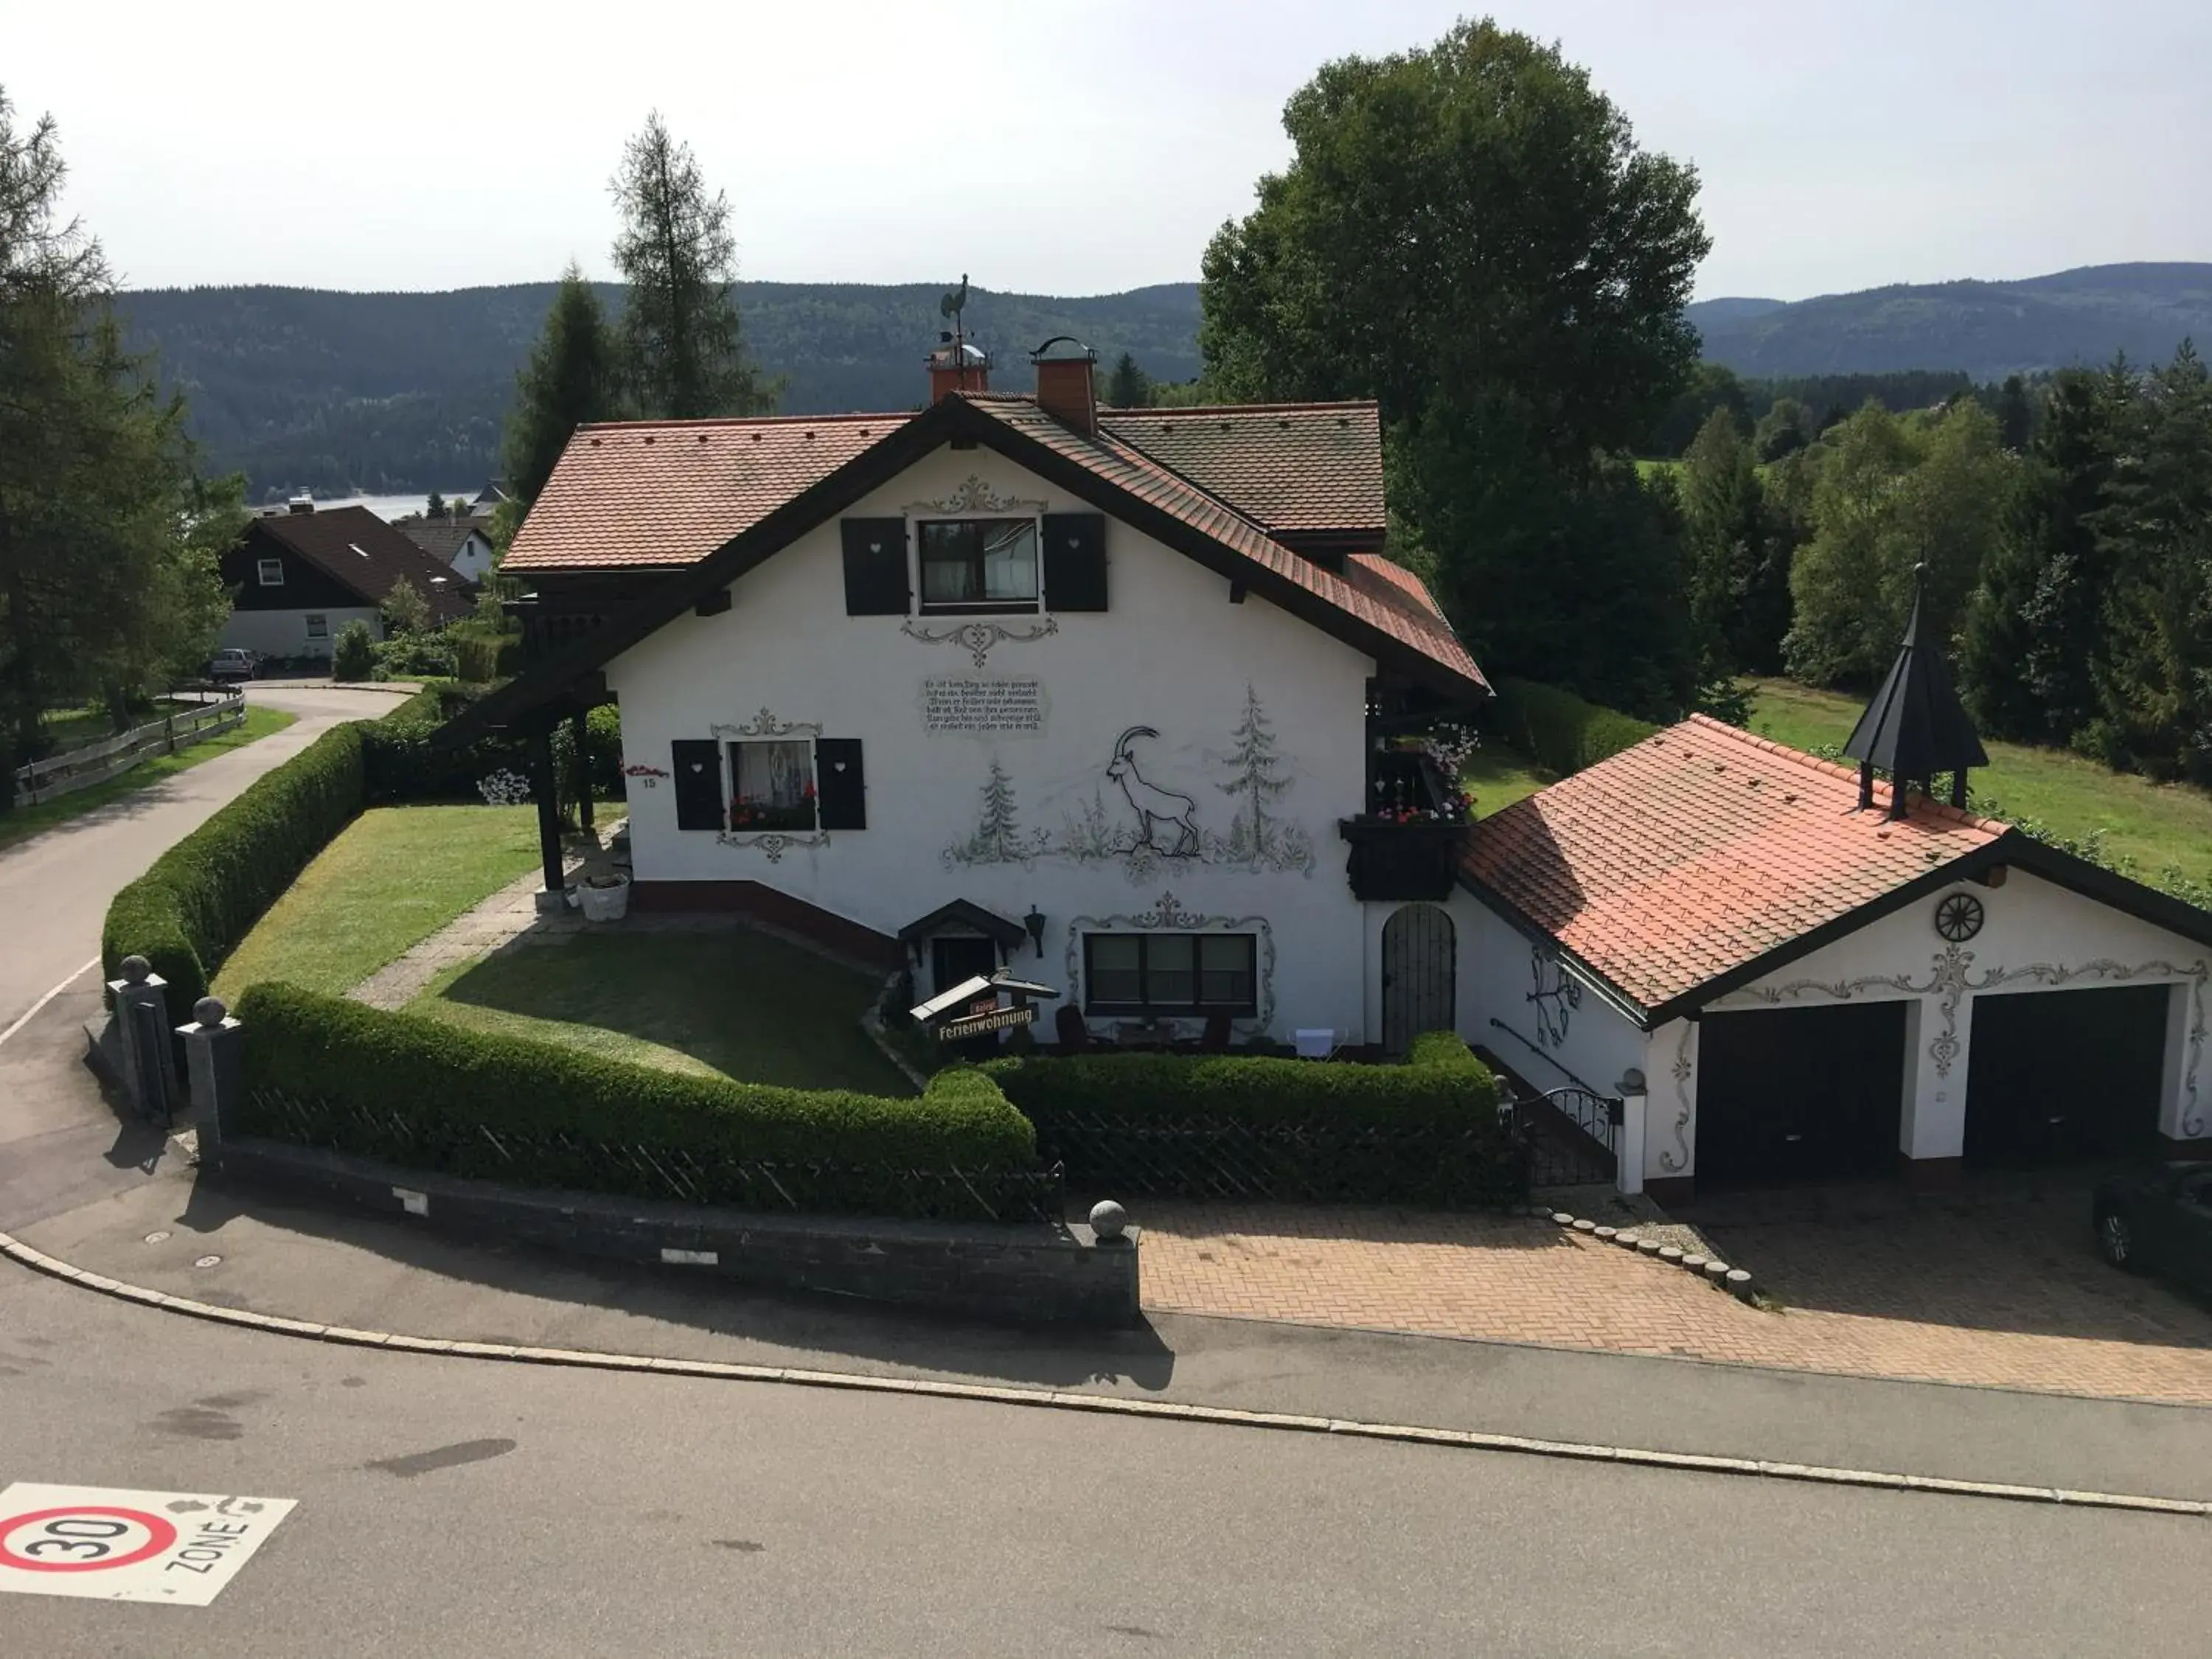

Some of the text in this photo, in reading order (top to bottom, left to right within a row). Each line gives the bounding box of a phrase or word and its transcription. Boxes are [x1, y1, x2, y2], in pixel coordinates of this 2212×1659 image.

[643, 778, 655, 788] 15
[939, 1009, 1032, 1040] Ferienwohnung
[24, 1519, 129, 1559] 30
[164, 1521, 249, 1574] ZONE
